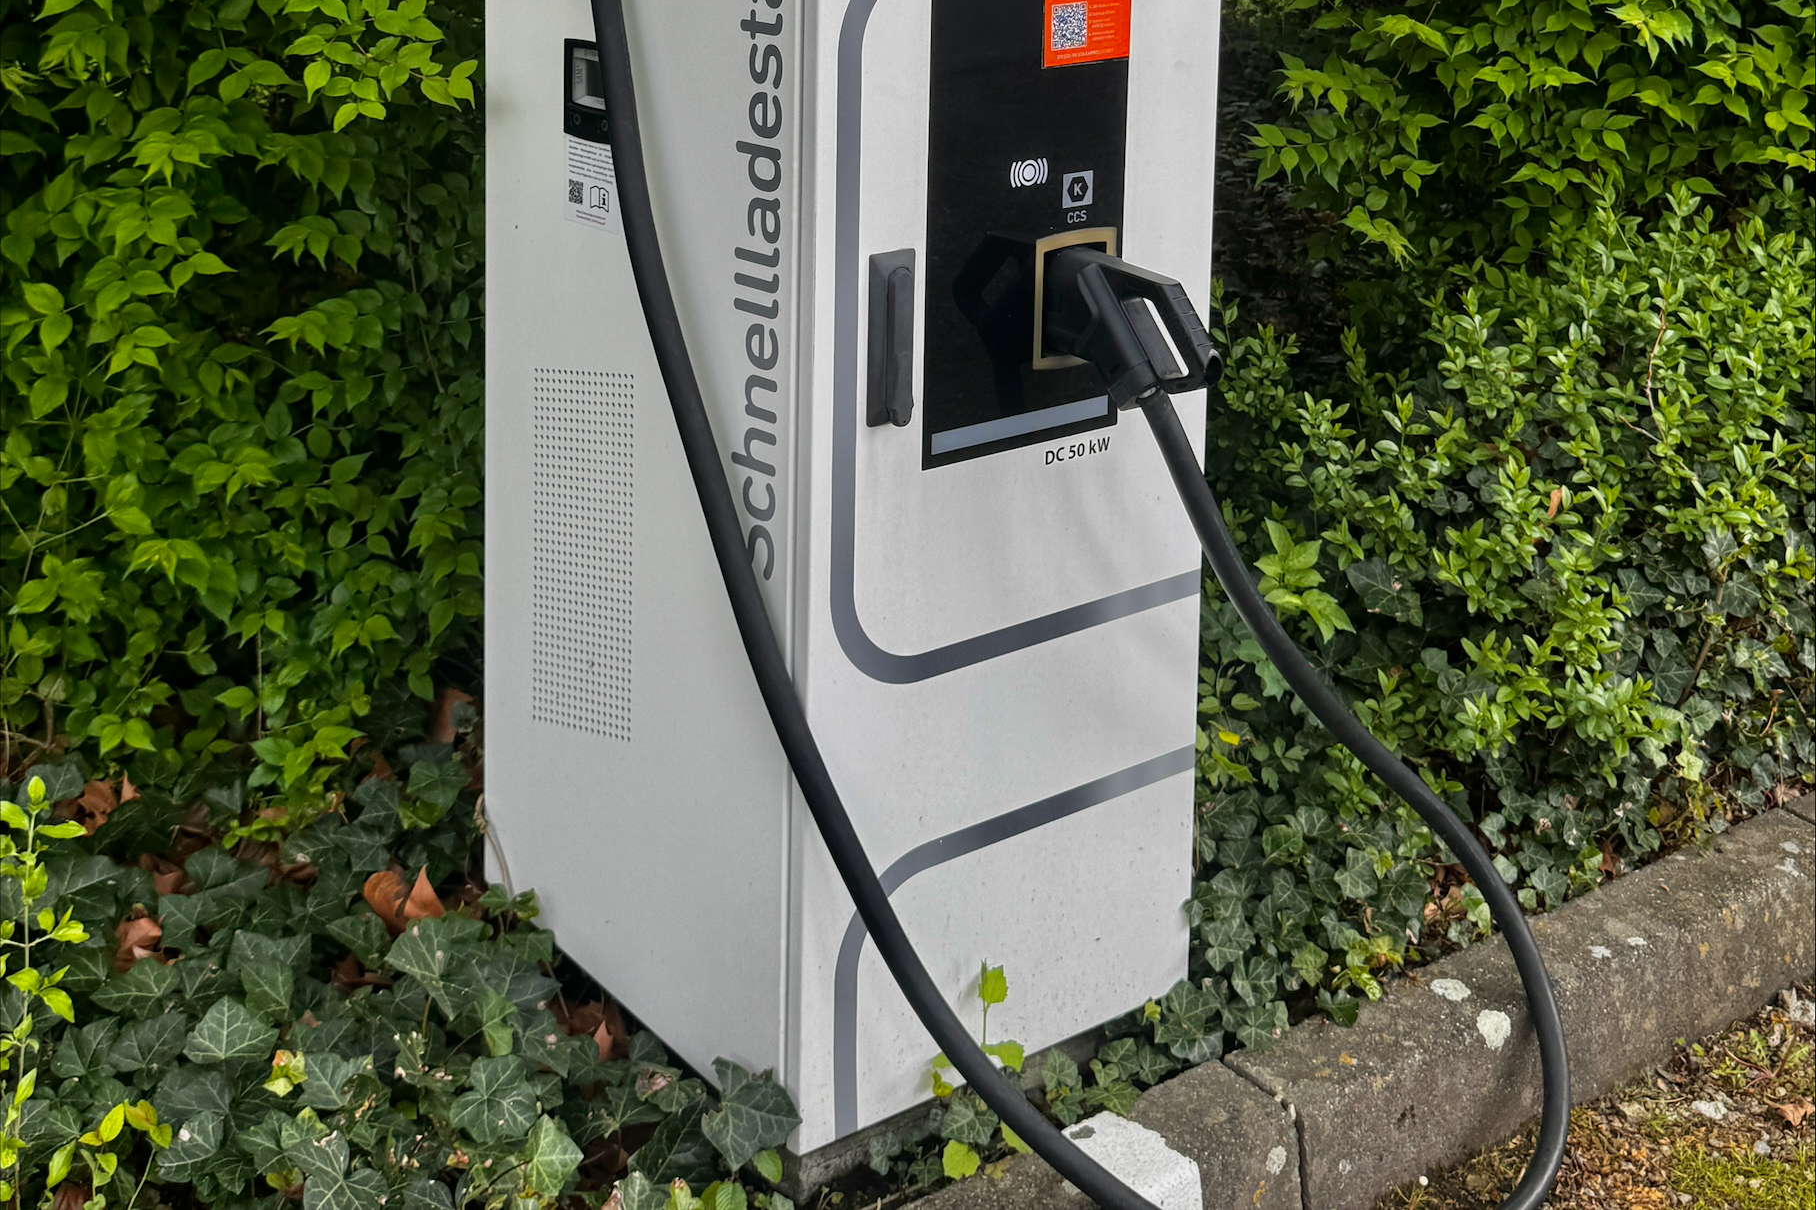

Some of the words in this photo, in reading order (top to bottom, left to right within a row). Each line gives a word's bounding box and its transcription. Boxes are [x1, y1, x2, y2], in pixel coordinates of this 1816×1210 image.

[1073, 182, 1083, 196] K
[1067, 210, 1087, 224] CCS
[1044, 447, 1065, 466] DC
[1068, 443, 1085, 459] 50
[1088, 436, 1111, 454] kW
